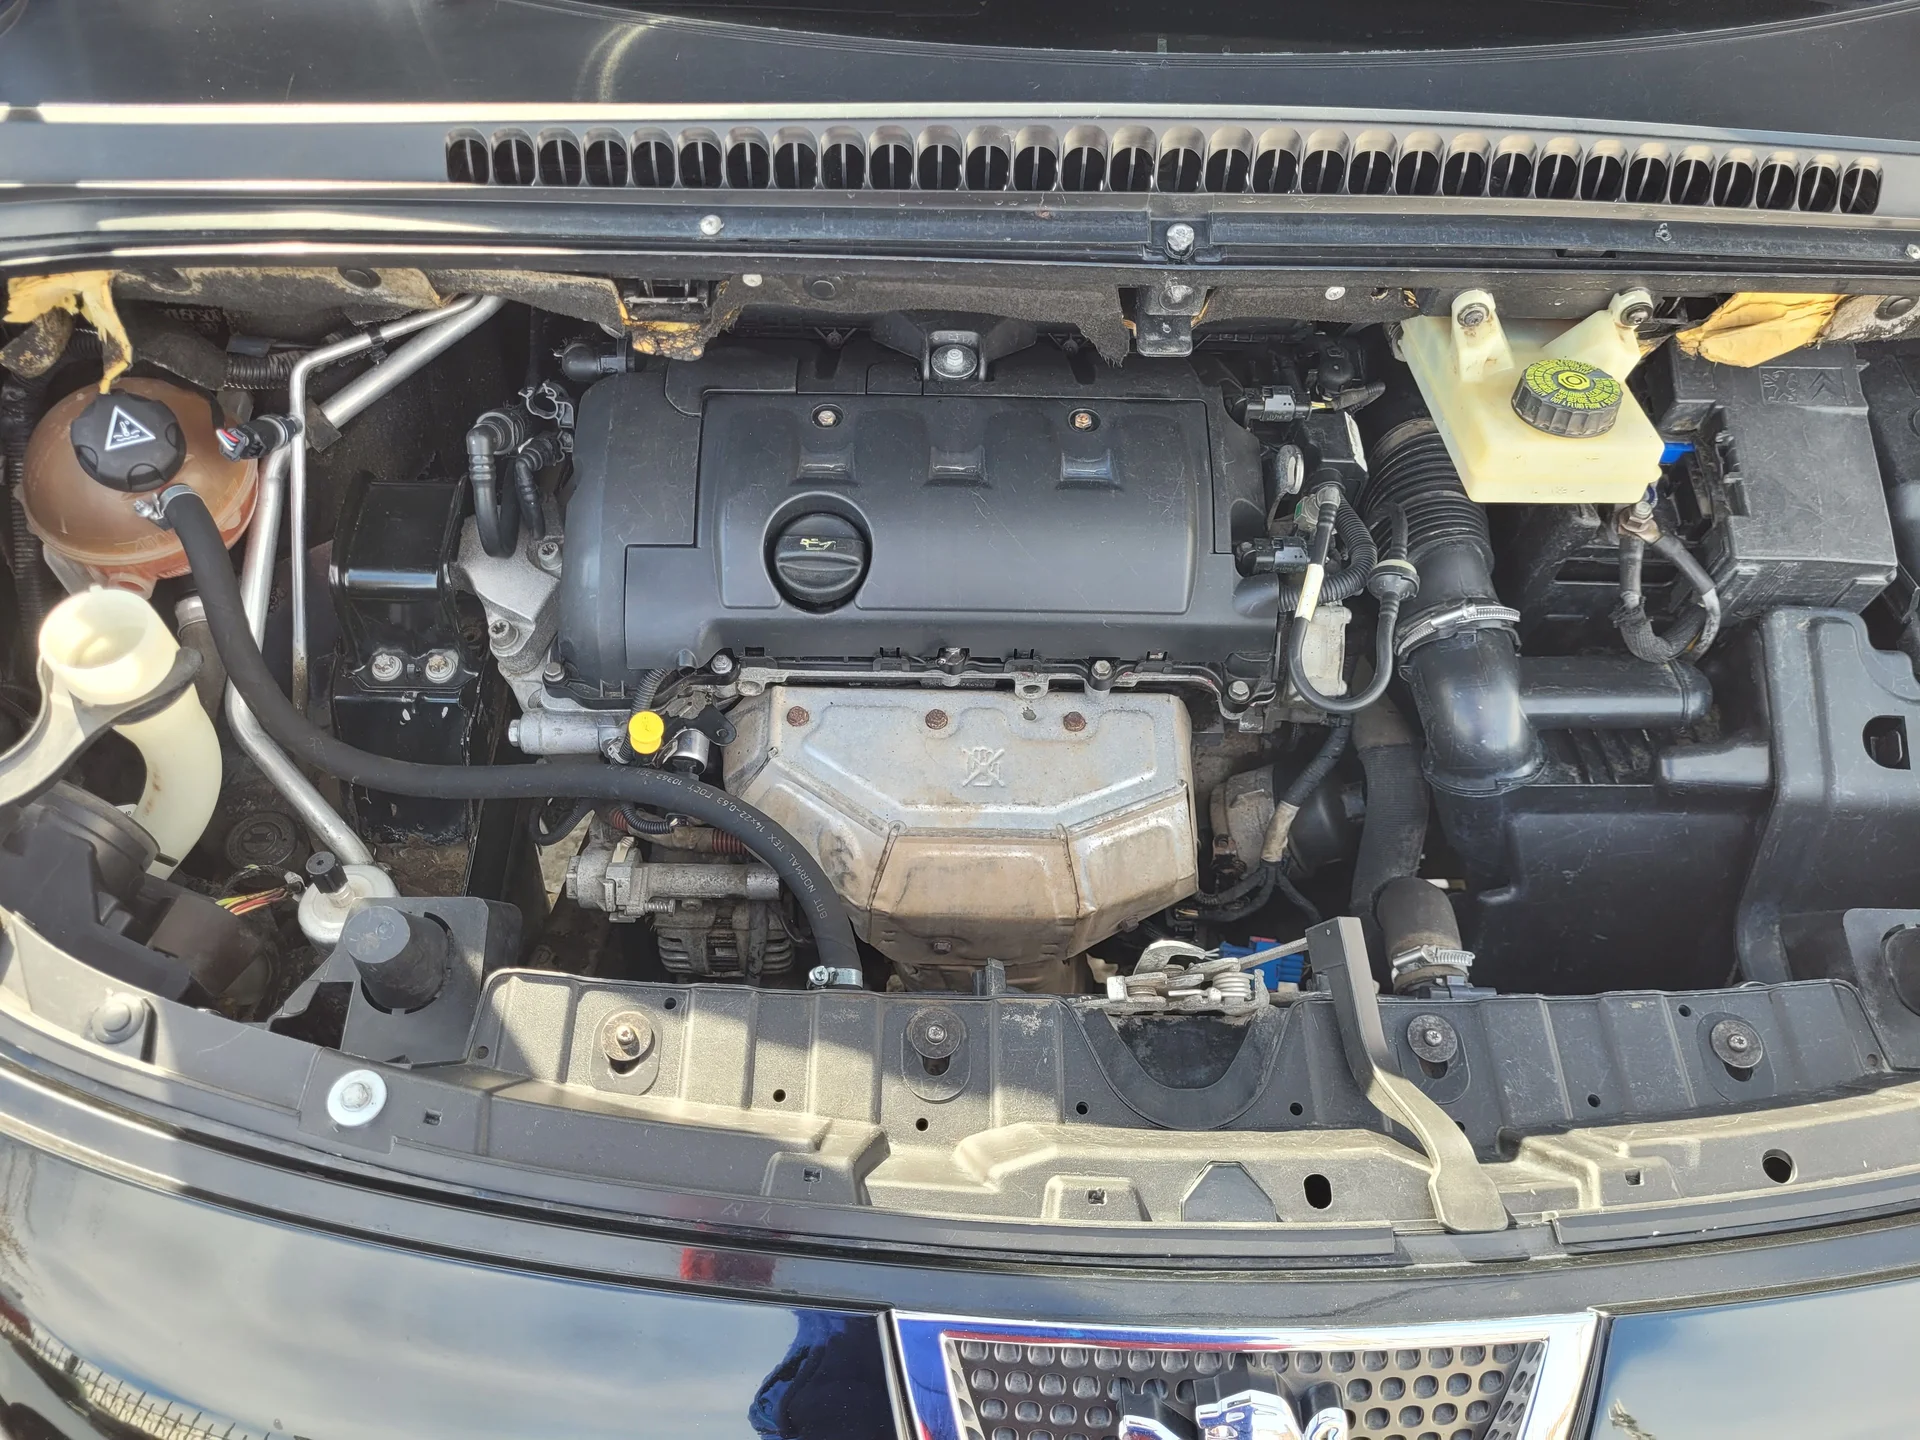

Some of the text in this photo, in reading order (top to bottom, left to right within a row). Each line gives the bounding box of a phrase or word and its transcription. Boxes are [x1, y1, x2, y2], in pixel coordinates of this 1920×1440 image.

[656, 773, 682, 786] 10362
[767, 833, 785, 853] TEX
[788, 853, 816, 893] NORMAL
